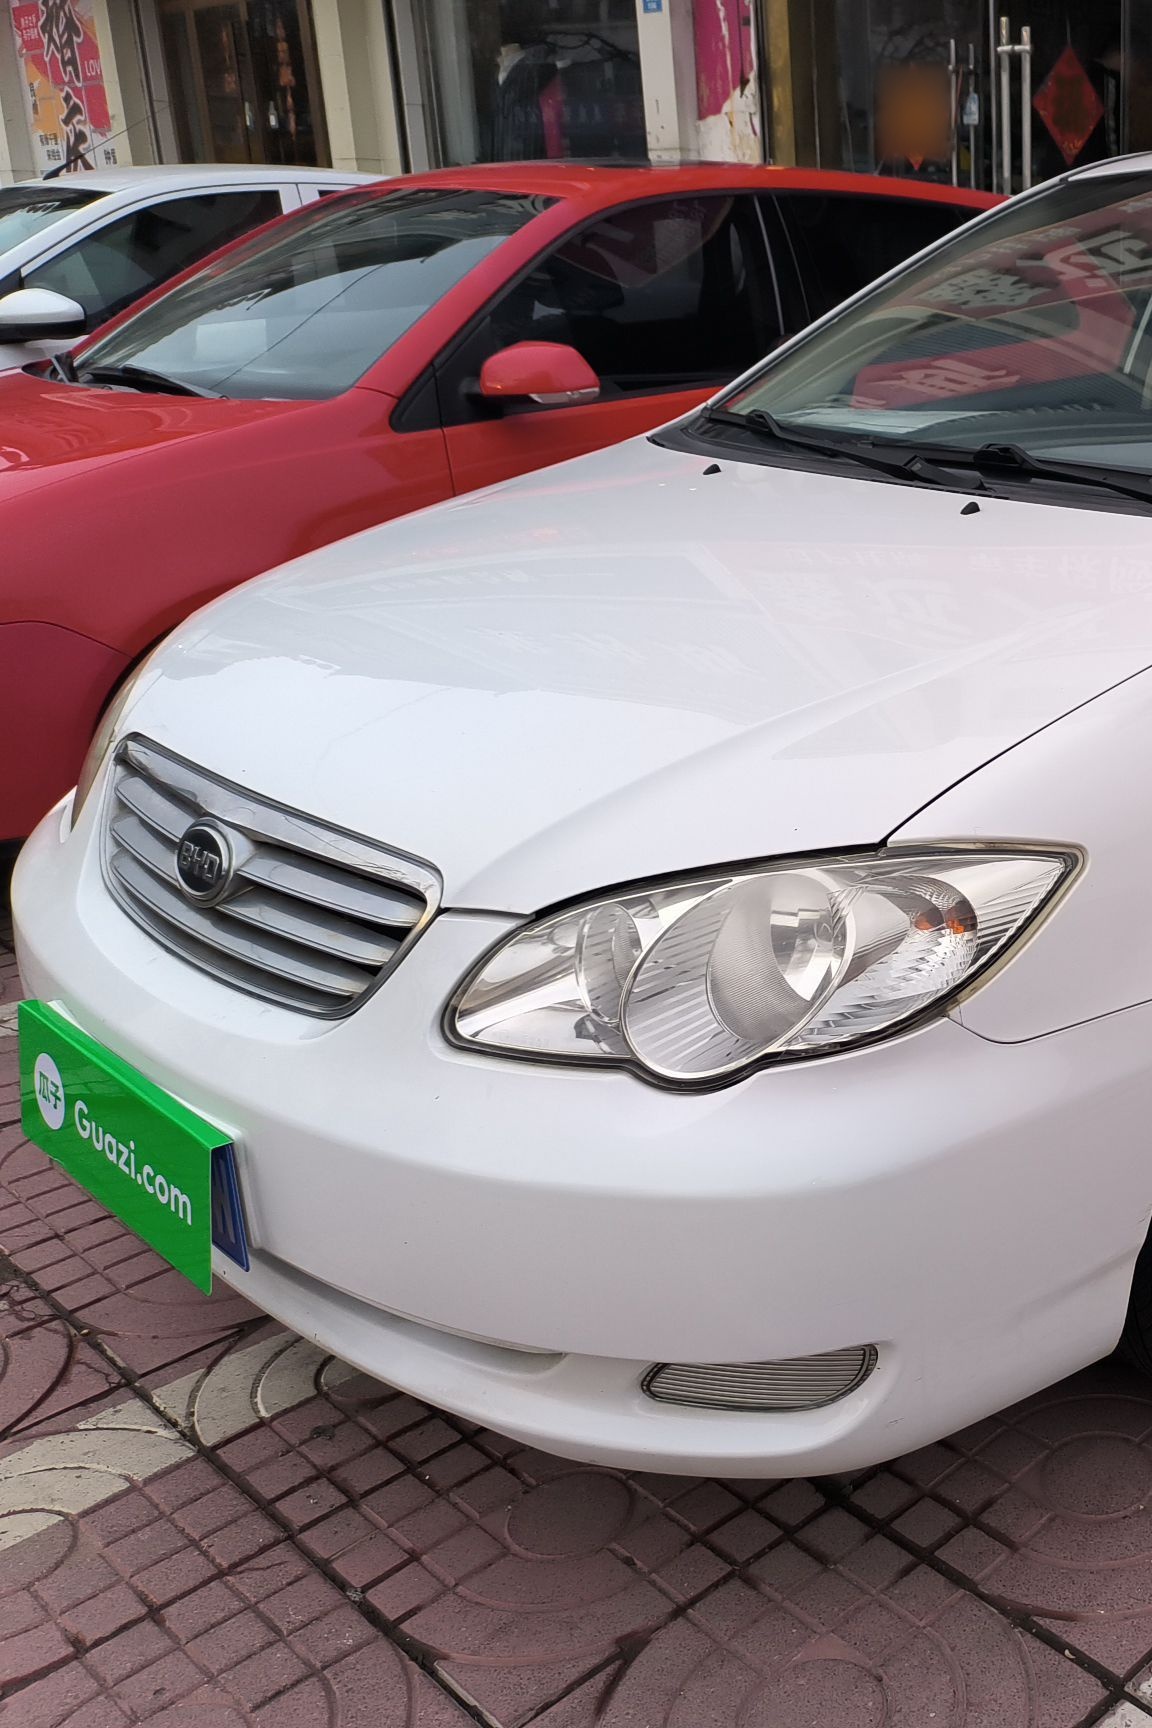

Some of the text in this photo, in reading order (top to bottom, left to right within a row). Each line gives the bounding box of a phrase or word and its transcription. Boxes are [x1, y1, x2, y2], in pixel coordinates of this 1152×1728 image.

[180, 840, 220, 882] BYD
[38, 1070, 62, 1110] 瓜子
[74, 1099, 193, 1226] Guazi.com
